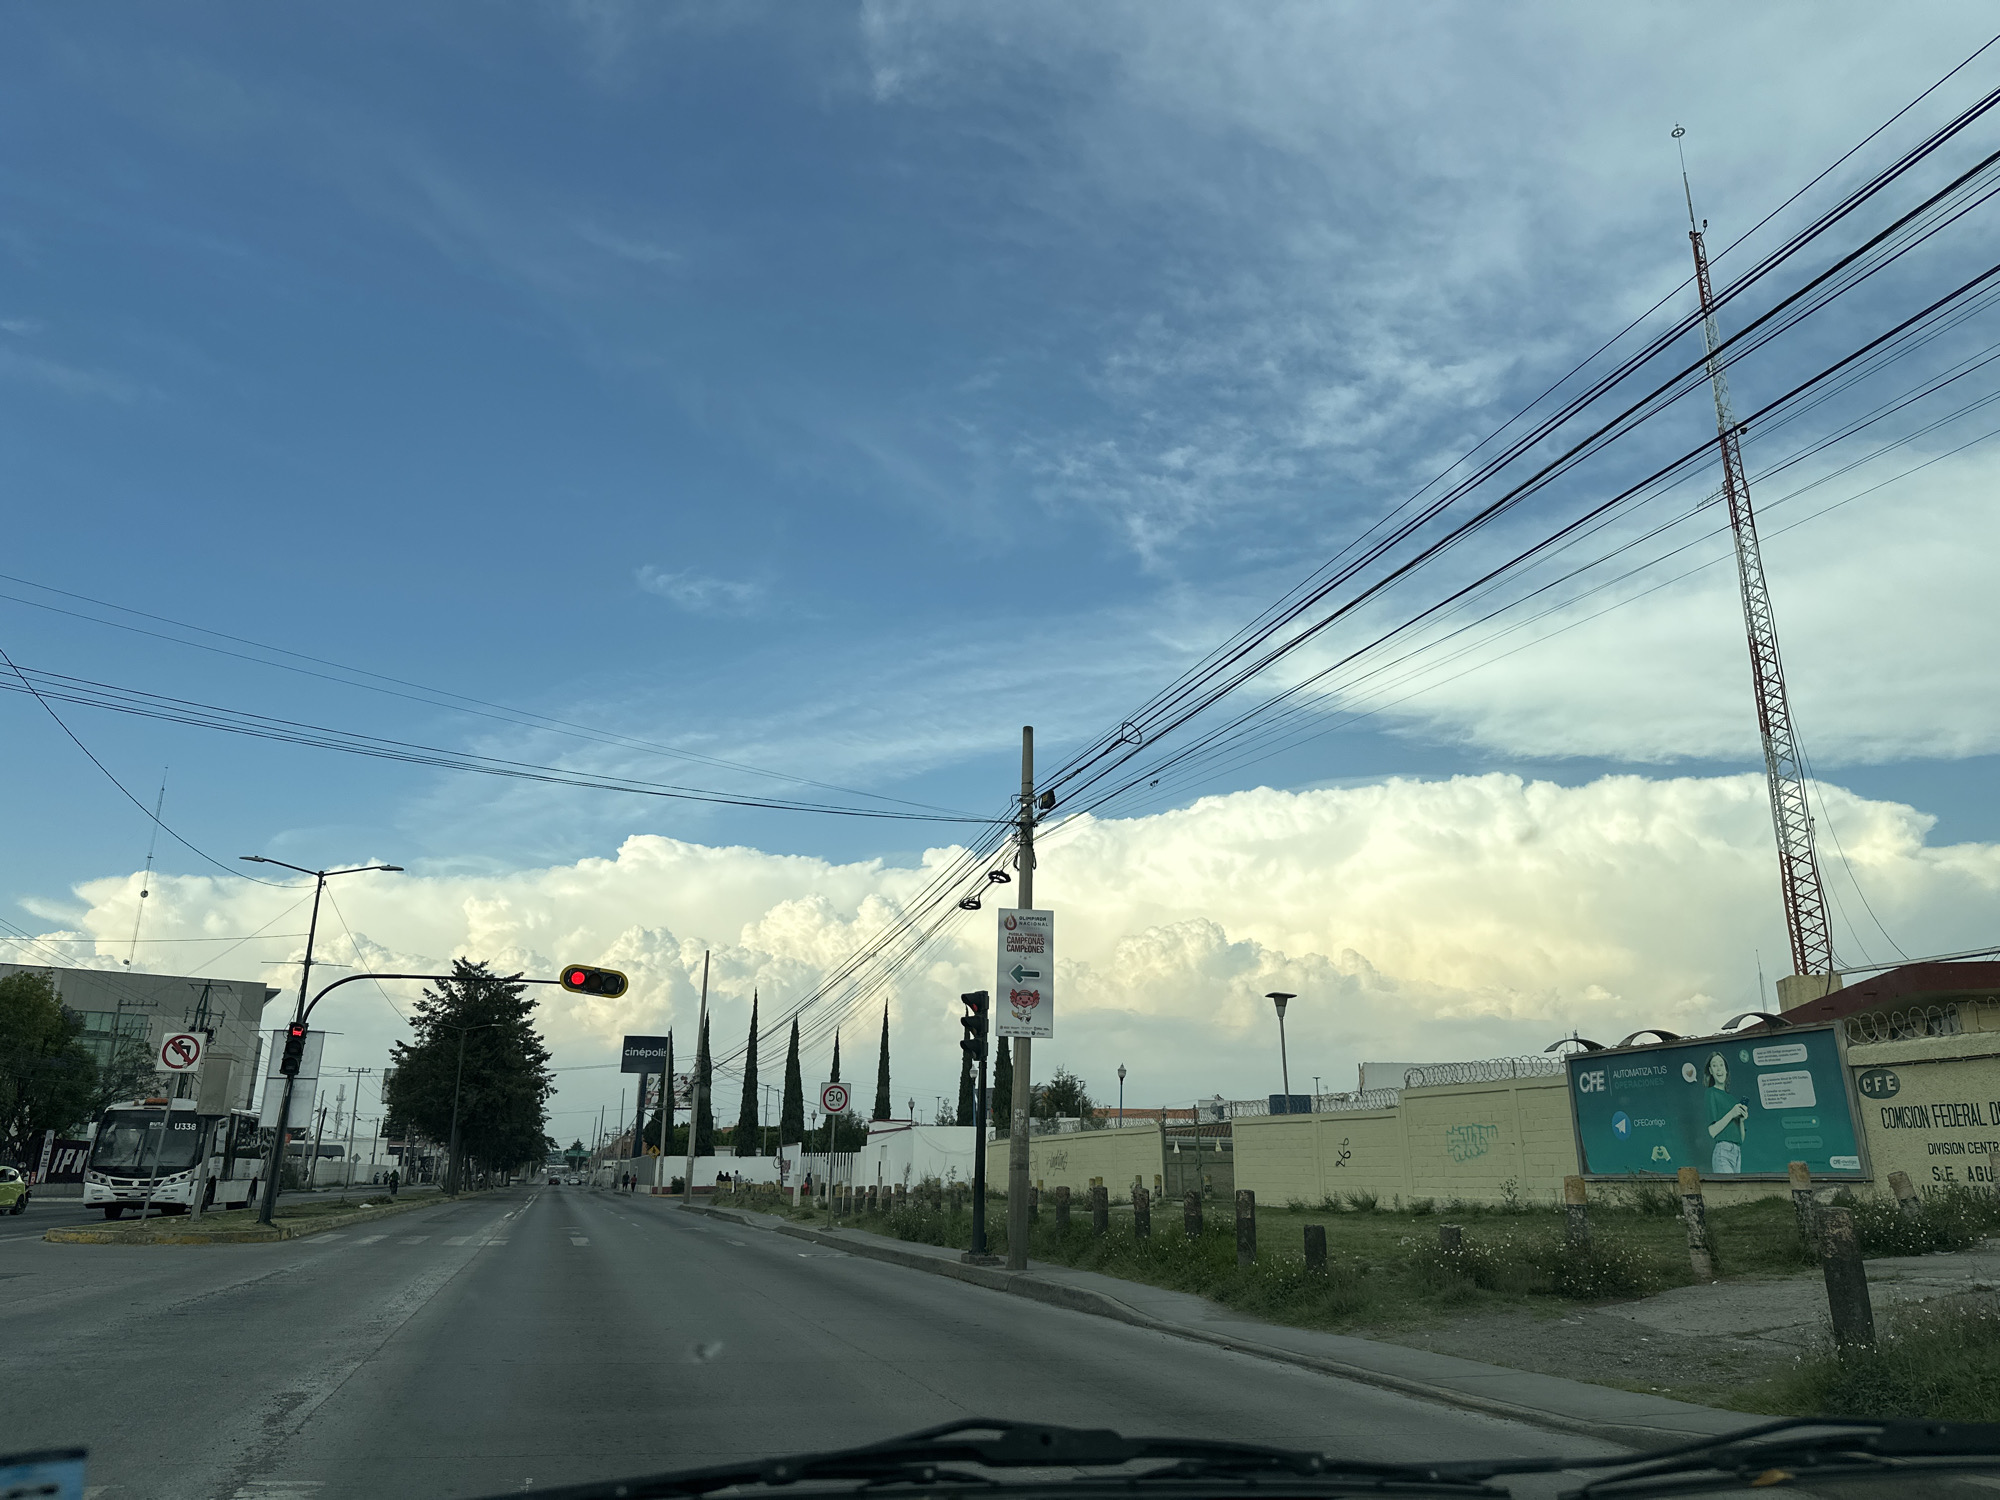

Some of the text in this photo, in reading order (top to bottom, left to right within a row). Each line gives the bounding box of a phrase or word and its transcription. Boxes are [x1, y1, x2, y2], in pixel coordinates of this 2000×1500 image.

[1006, 936, 1045, 945] CAMPEONAS
[1006, 944, 1045, 953] CAMPEONES
[1613, 1065, 1667, 1079] AUTOMATIZA TUS
[1580, 1070, 1605, 1093] CFE
[1614, 1078, 1665, 1089] OPERACIONES
[1862, 1075, 1897, 1093] CFE
[828, 1091, 842, 1102] 50
[1881, 1105, 1931, 1129] COMISION
[1932, 1103, 1987, 1128] FEDERAL
[174, 1122, 197, 1131] U338
[1928, 1142, 1965, 1155] DIVISION
[50, 1148, 89, 1174] IPN
